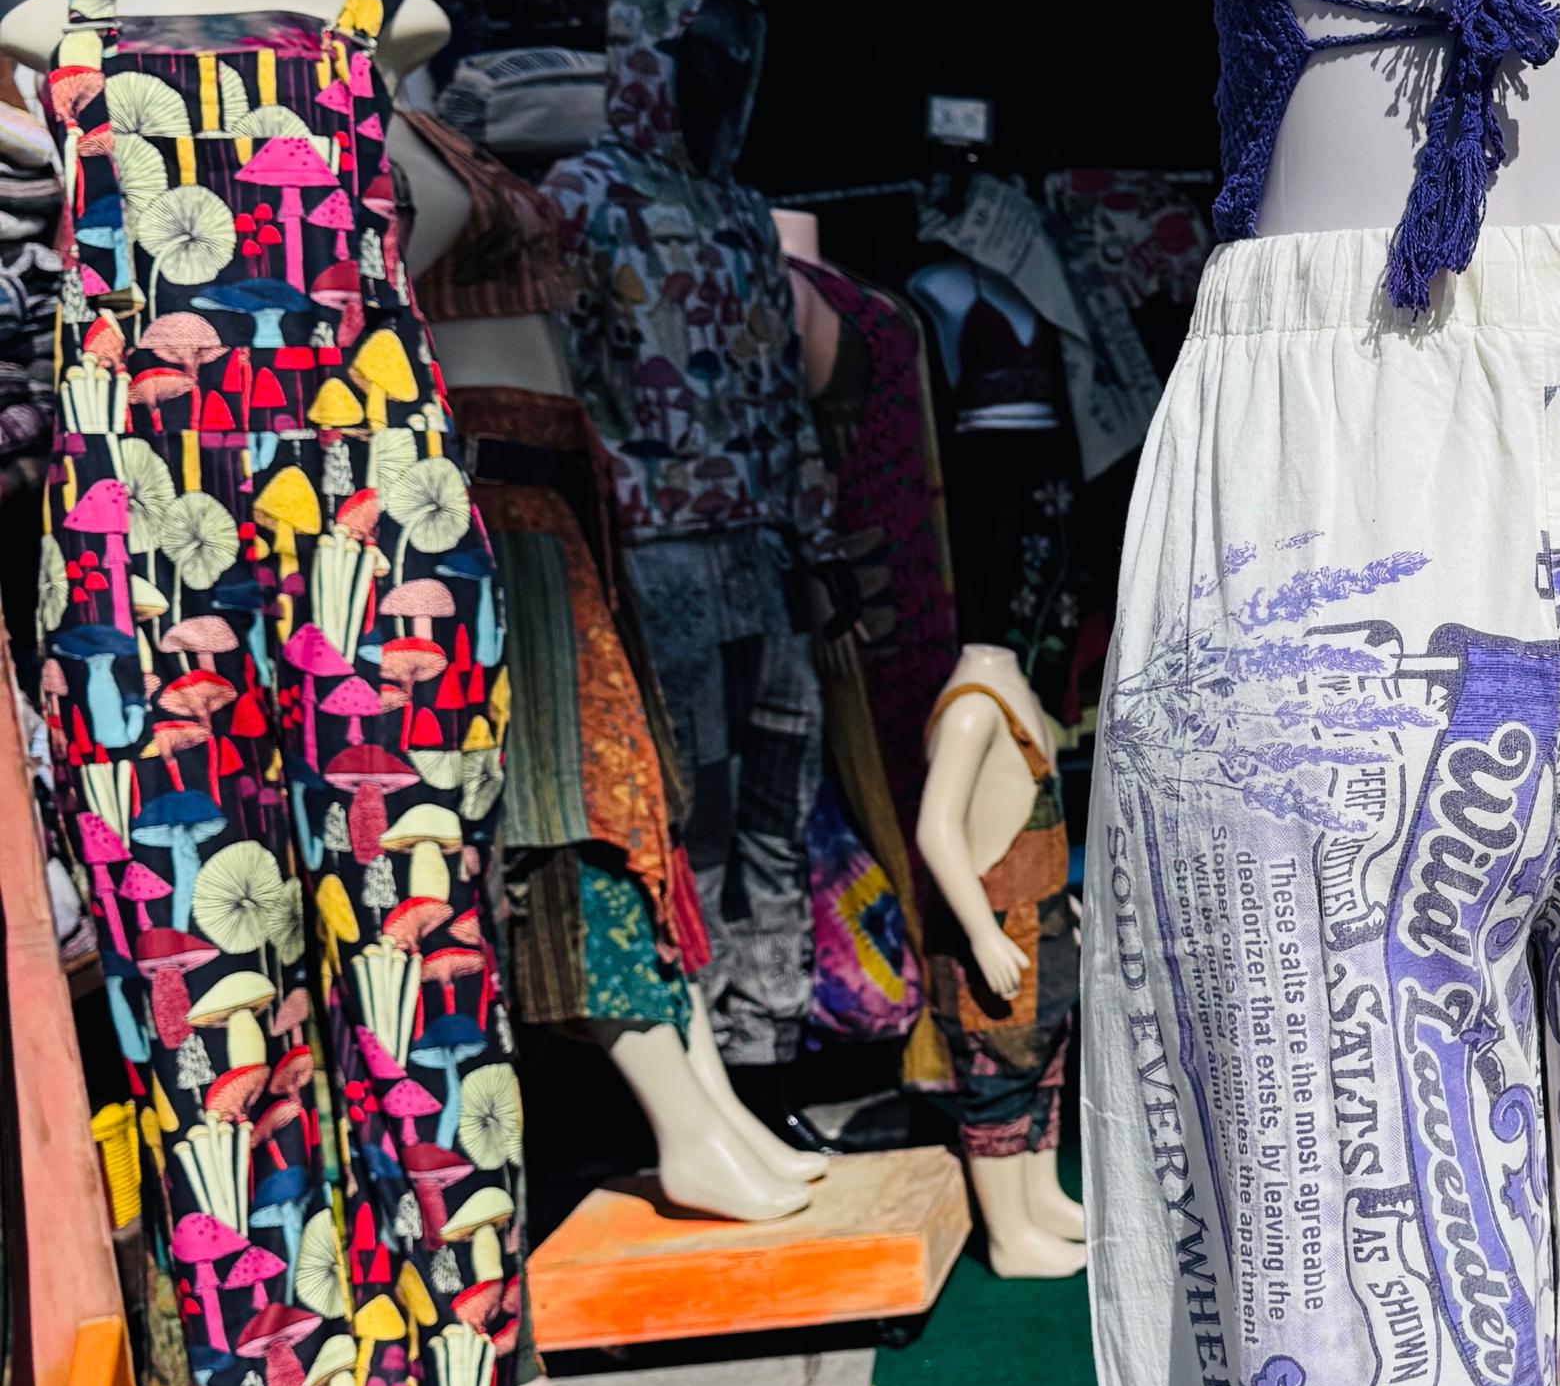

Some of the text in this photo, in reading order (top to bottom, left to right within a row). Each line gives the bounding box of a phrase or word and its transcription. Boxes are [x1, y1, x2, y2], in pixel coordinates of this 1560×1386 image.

[1105, 825, 1148, 991] SOLD
[1212, 826, 1232, 924] Stopper
[1236, 851, 1268, 987] deodorizer
[1227, 1002, 1242, 1047] few
[1250, 995, 1276, 1046] that
[1405, 728, 1534, 1380] Wild Lavender
[1232, 1055, 1250, 1156] minutes
[1270, 858, 1327, 1311] These salts are the most agreeable
[1239, 1165, 1255, 1204] the
[1257, 1144, 1288, 1173] by
[1263, 1181, 1290, 1271] leaving
[1352, 1227, 1390, 1263] AS
[1237, 1212, 1259, 1346] apartment
[1267, 1281, 1291, 1321] the
